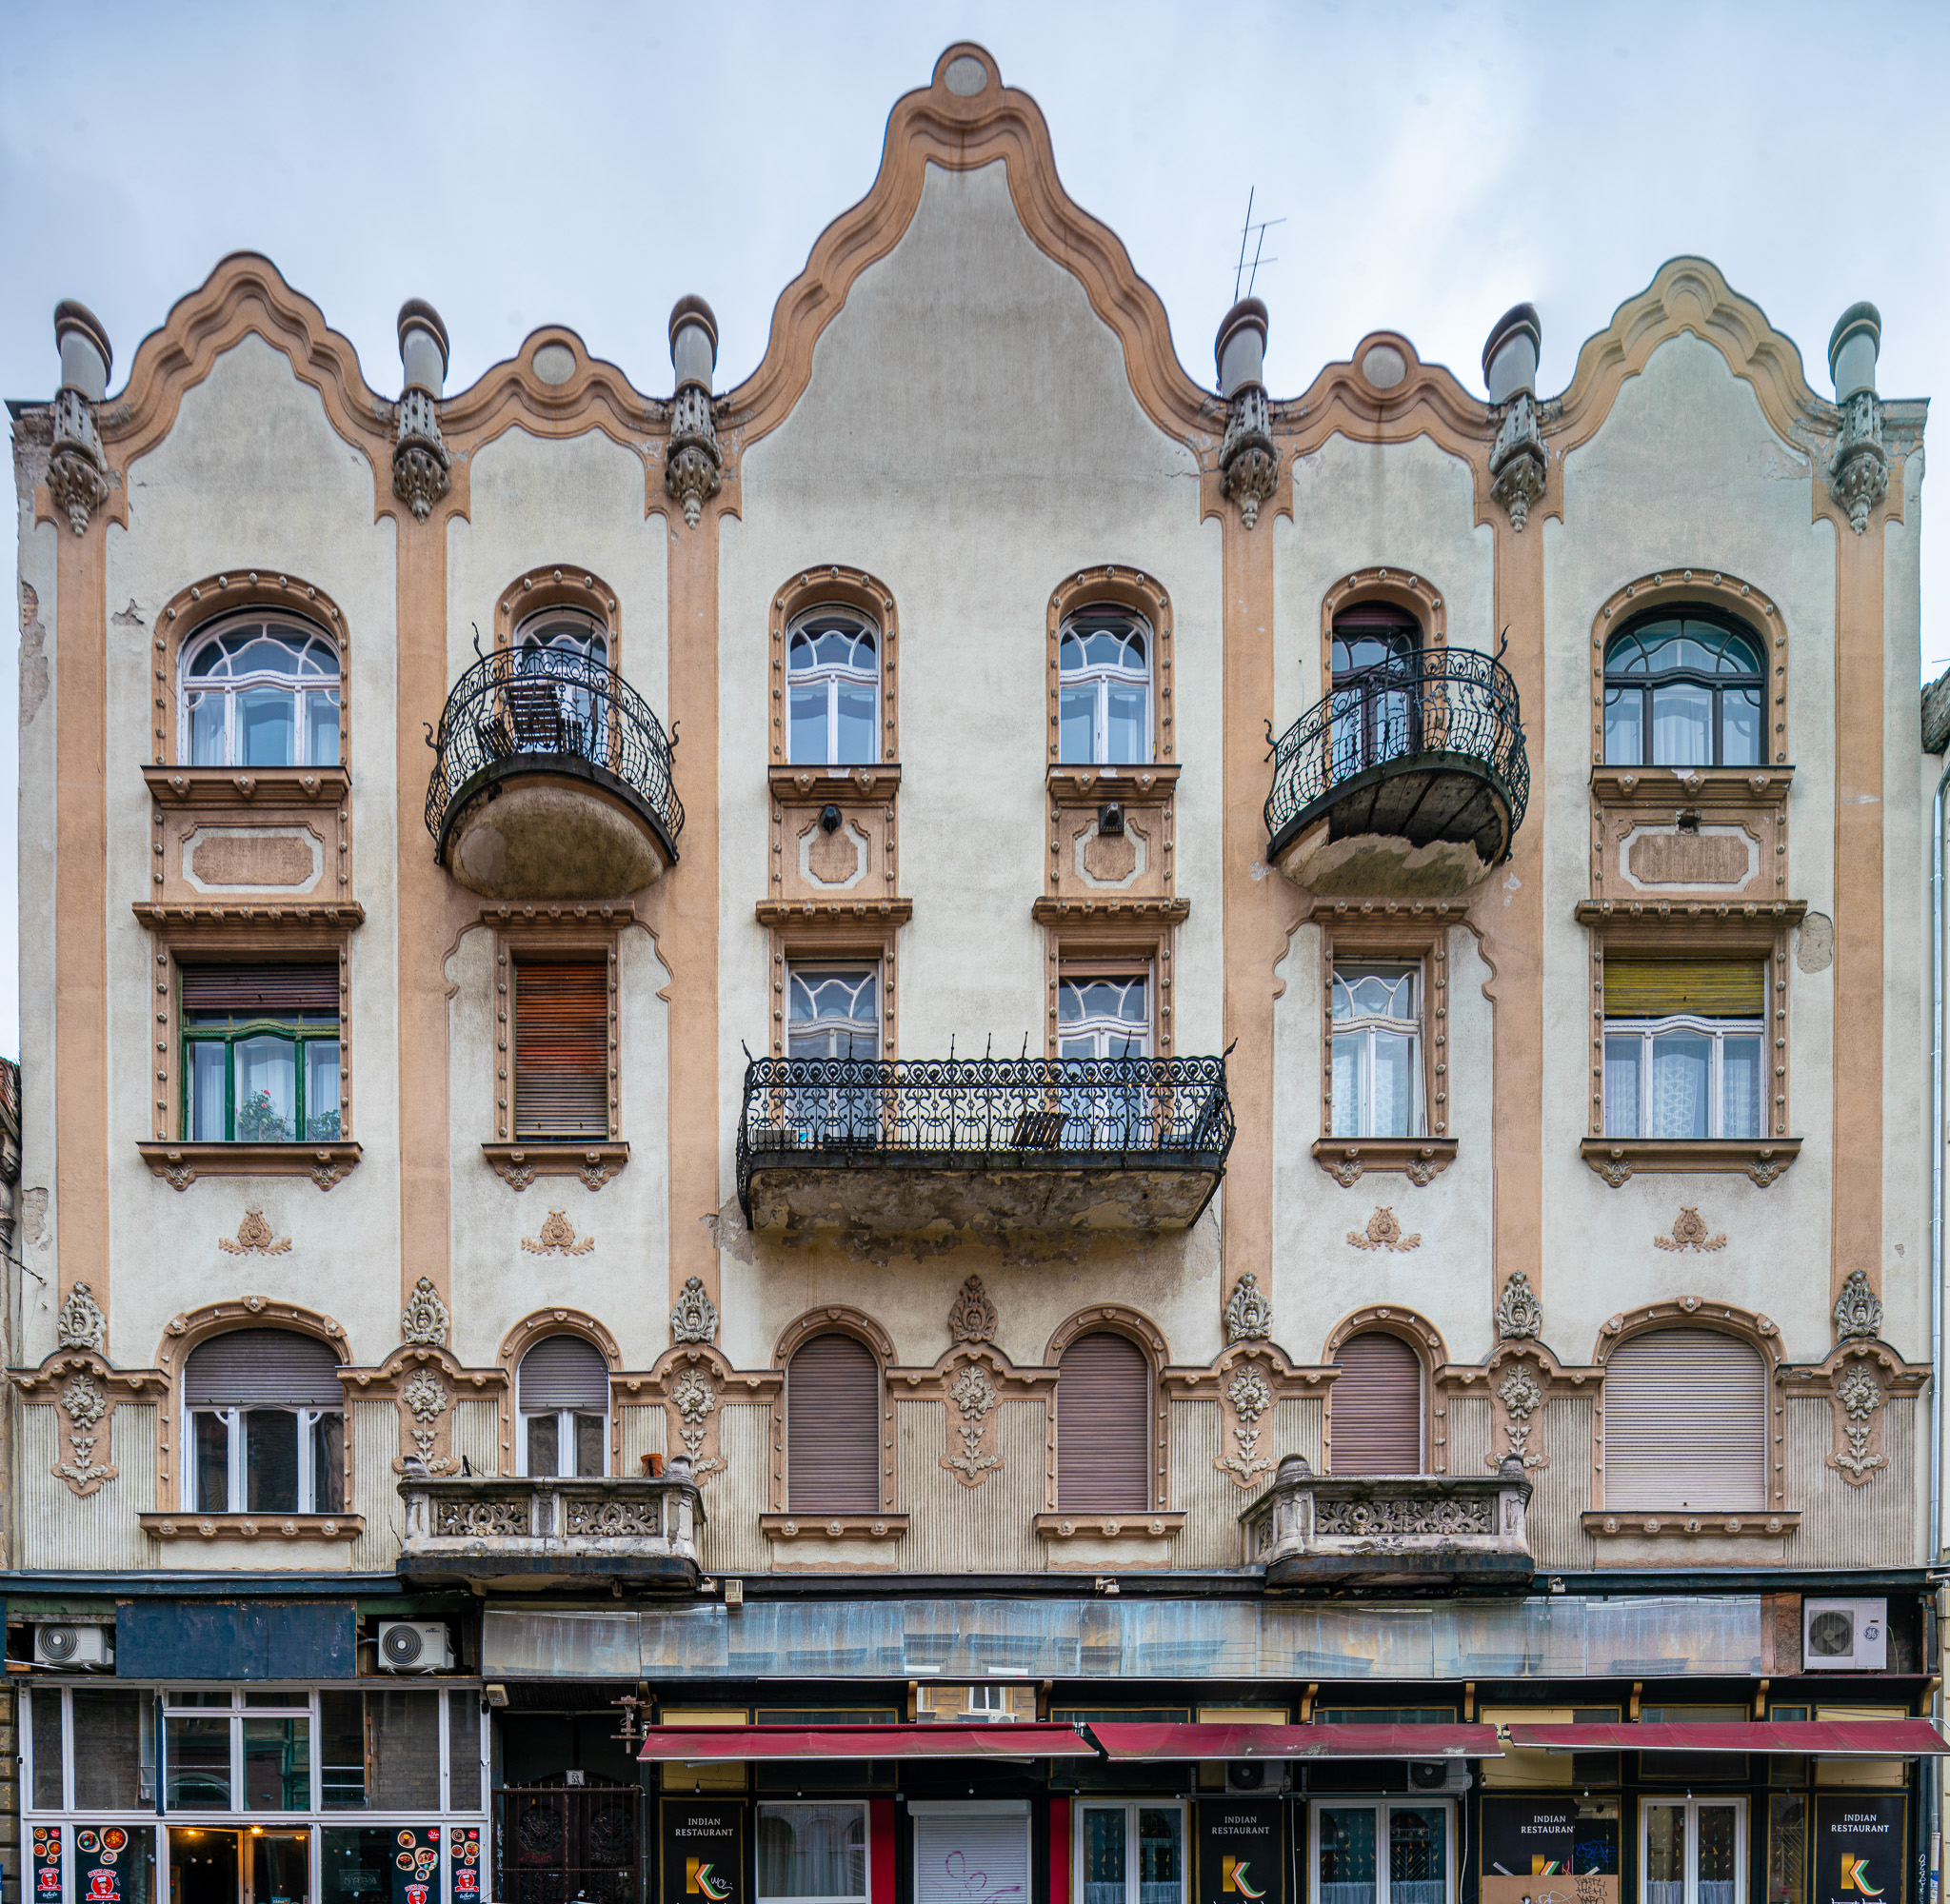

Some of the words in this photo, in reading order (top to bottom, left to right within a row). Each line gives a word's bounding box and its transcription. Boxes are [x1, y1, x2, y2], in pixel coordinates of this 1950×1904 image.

[571, 1775, 580, 1784] 53
[687, 1817, 721, 1826] INDIAN
[1224, 1815, 1257, 1824] INDIAN
[1533, 1815, 1565, 1823] INDIAN
[675, 1828, 734, 1836] RESTAURANT
[1211, 1826, 1270, 1835] RESTAURANT
[1521, 1825, 1575, 1834] RESTAURAN
